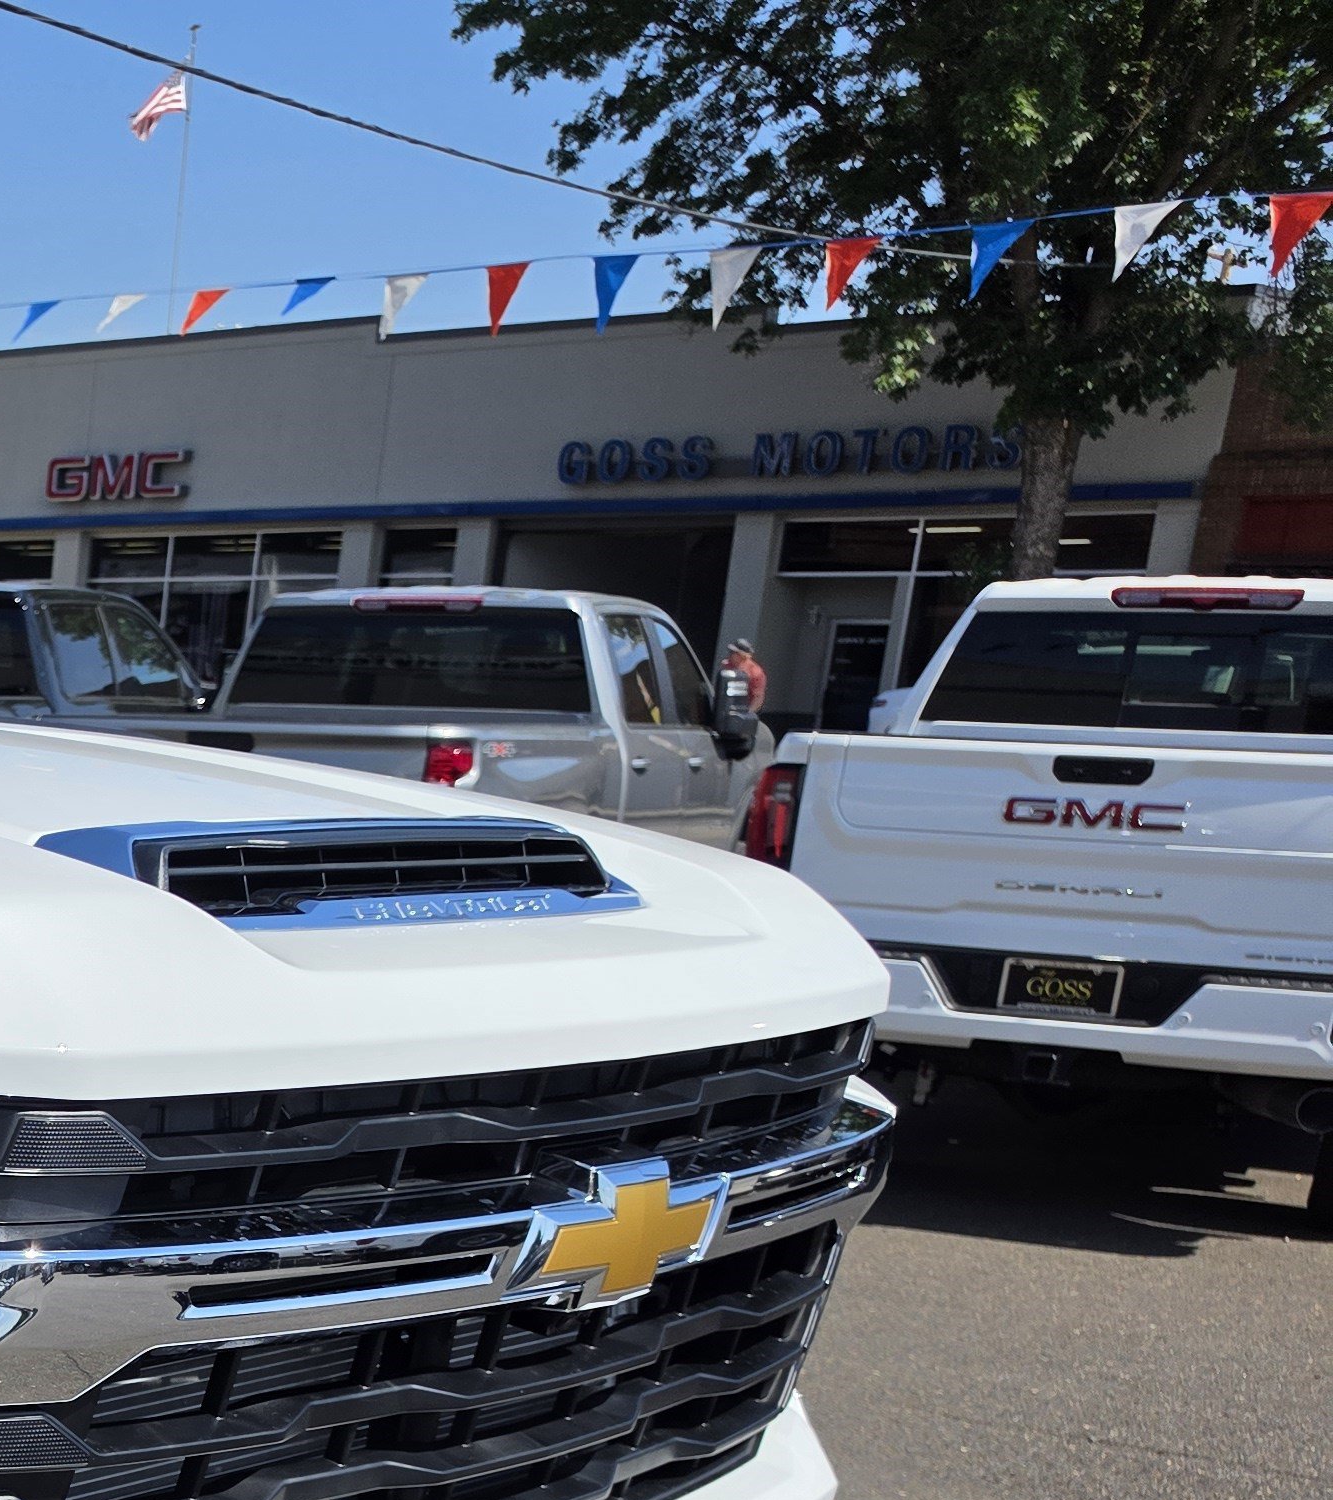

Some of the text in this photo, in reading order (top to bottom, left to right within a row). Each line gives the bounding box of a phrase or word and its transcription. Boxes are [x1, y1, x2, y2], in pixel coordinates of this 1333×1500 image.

[557, 423, 1023, 486] GOSS MOTORS
[45, 451, 188, 503] GMC
[1002, 796, 1188, 831] GMC
[994, 879, 1164, 899] DENALI
[1026, 977, 1094, 1001] GOSS
